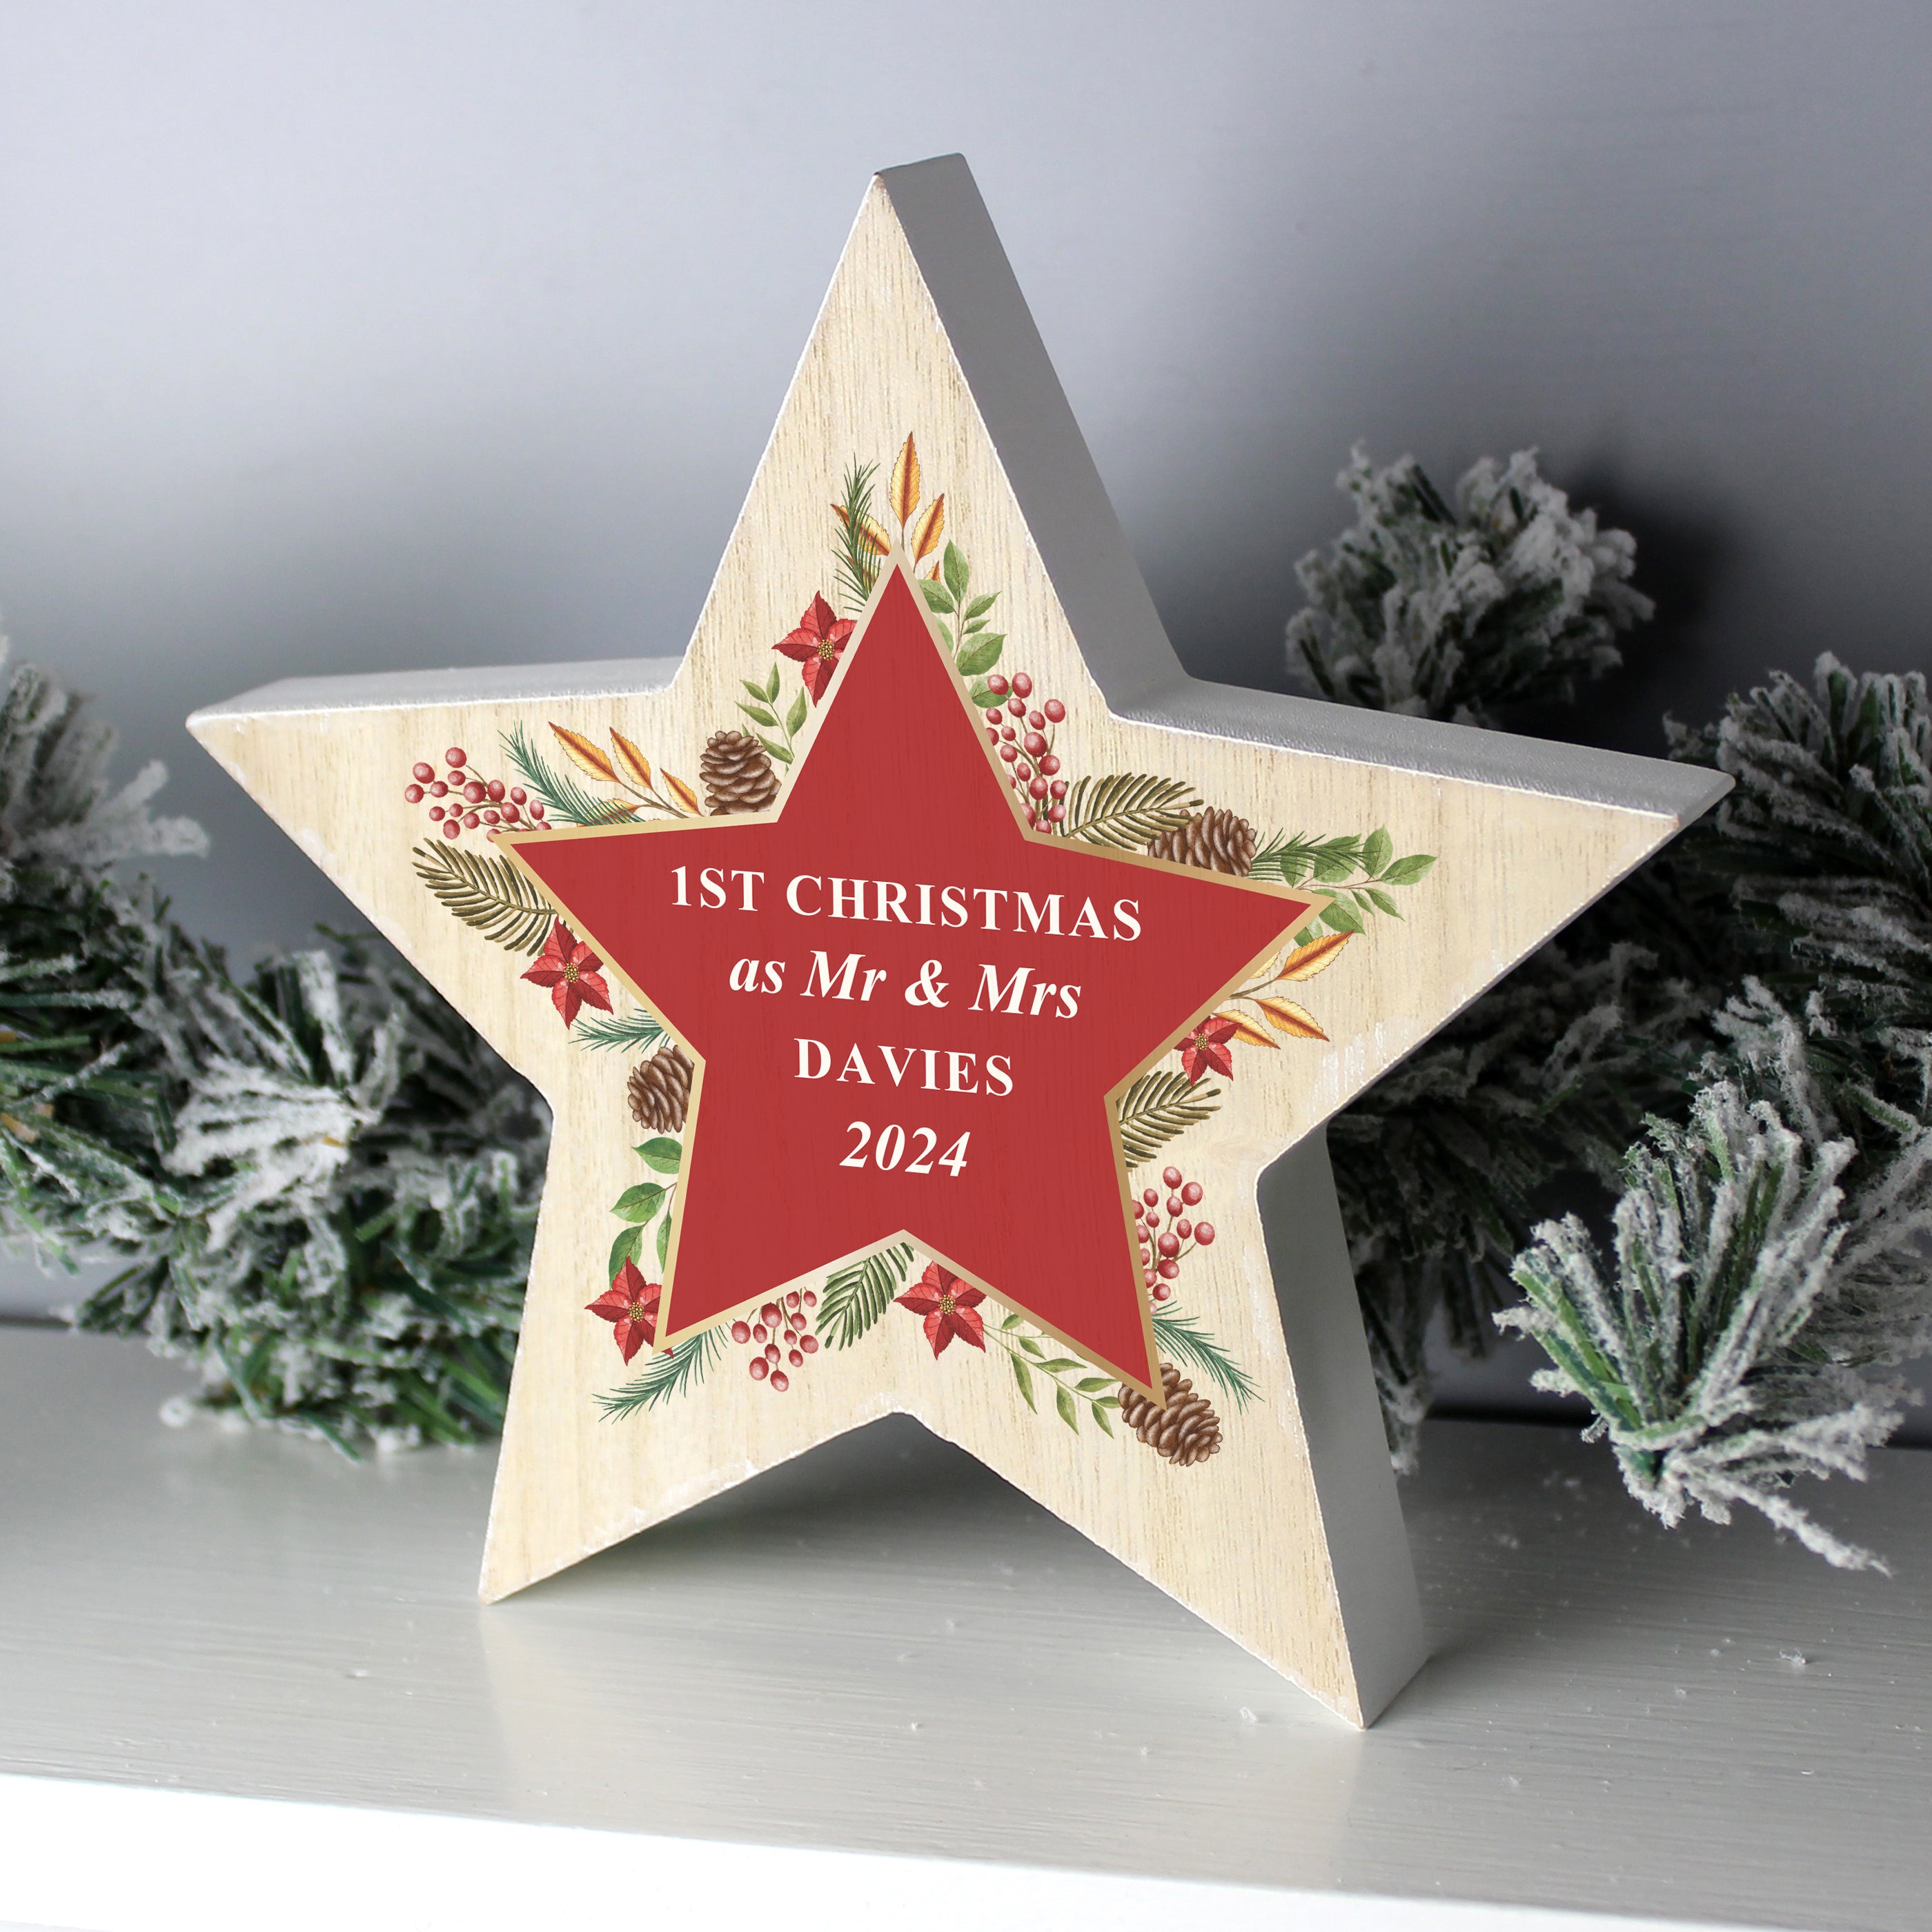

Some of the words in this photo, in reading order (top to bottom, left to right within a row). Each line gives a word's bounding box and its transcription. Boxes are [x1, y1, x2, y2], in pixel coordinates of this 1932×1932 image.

[671, 865, 765, 911] 1ST
[786, 874, 1142, 941] CHRISTMAS
[729, 958, 786, 994] as
[799, 950, 887, 1001] Mr
[905, 959, 949, 1008] &
[967, 964, 1082, 1018] Mrs
[793, 1038, 1014, 1096] DAVIES
[839, 1121, 971, 1177] 2024
